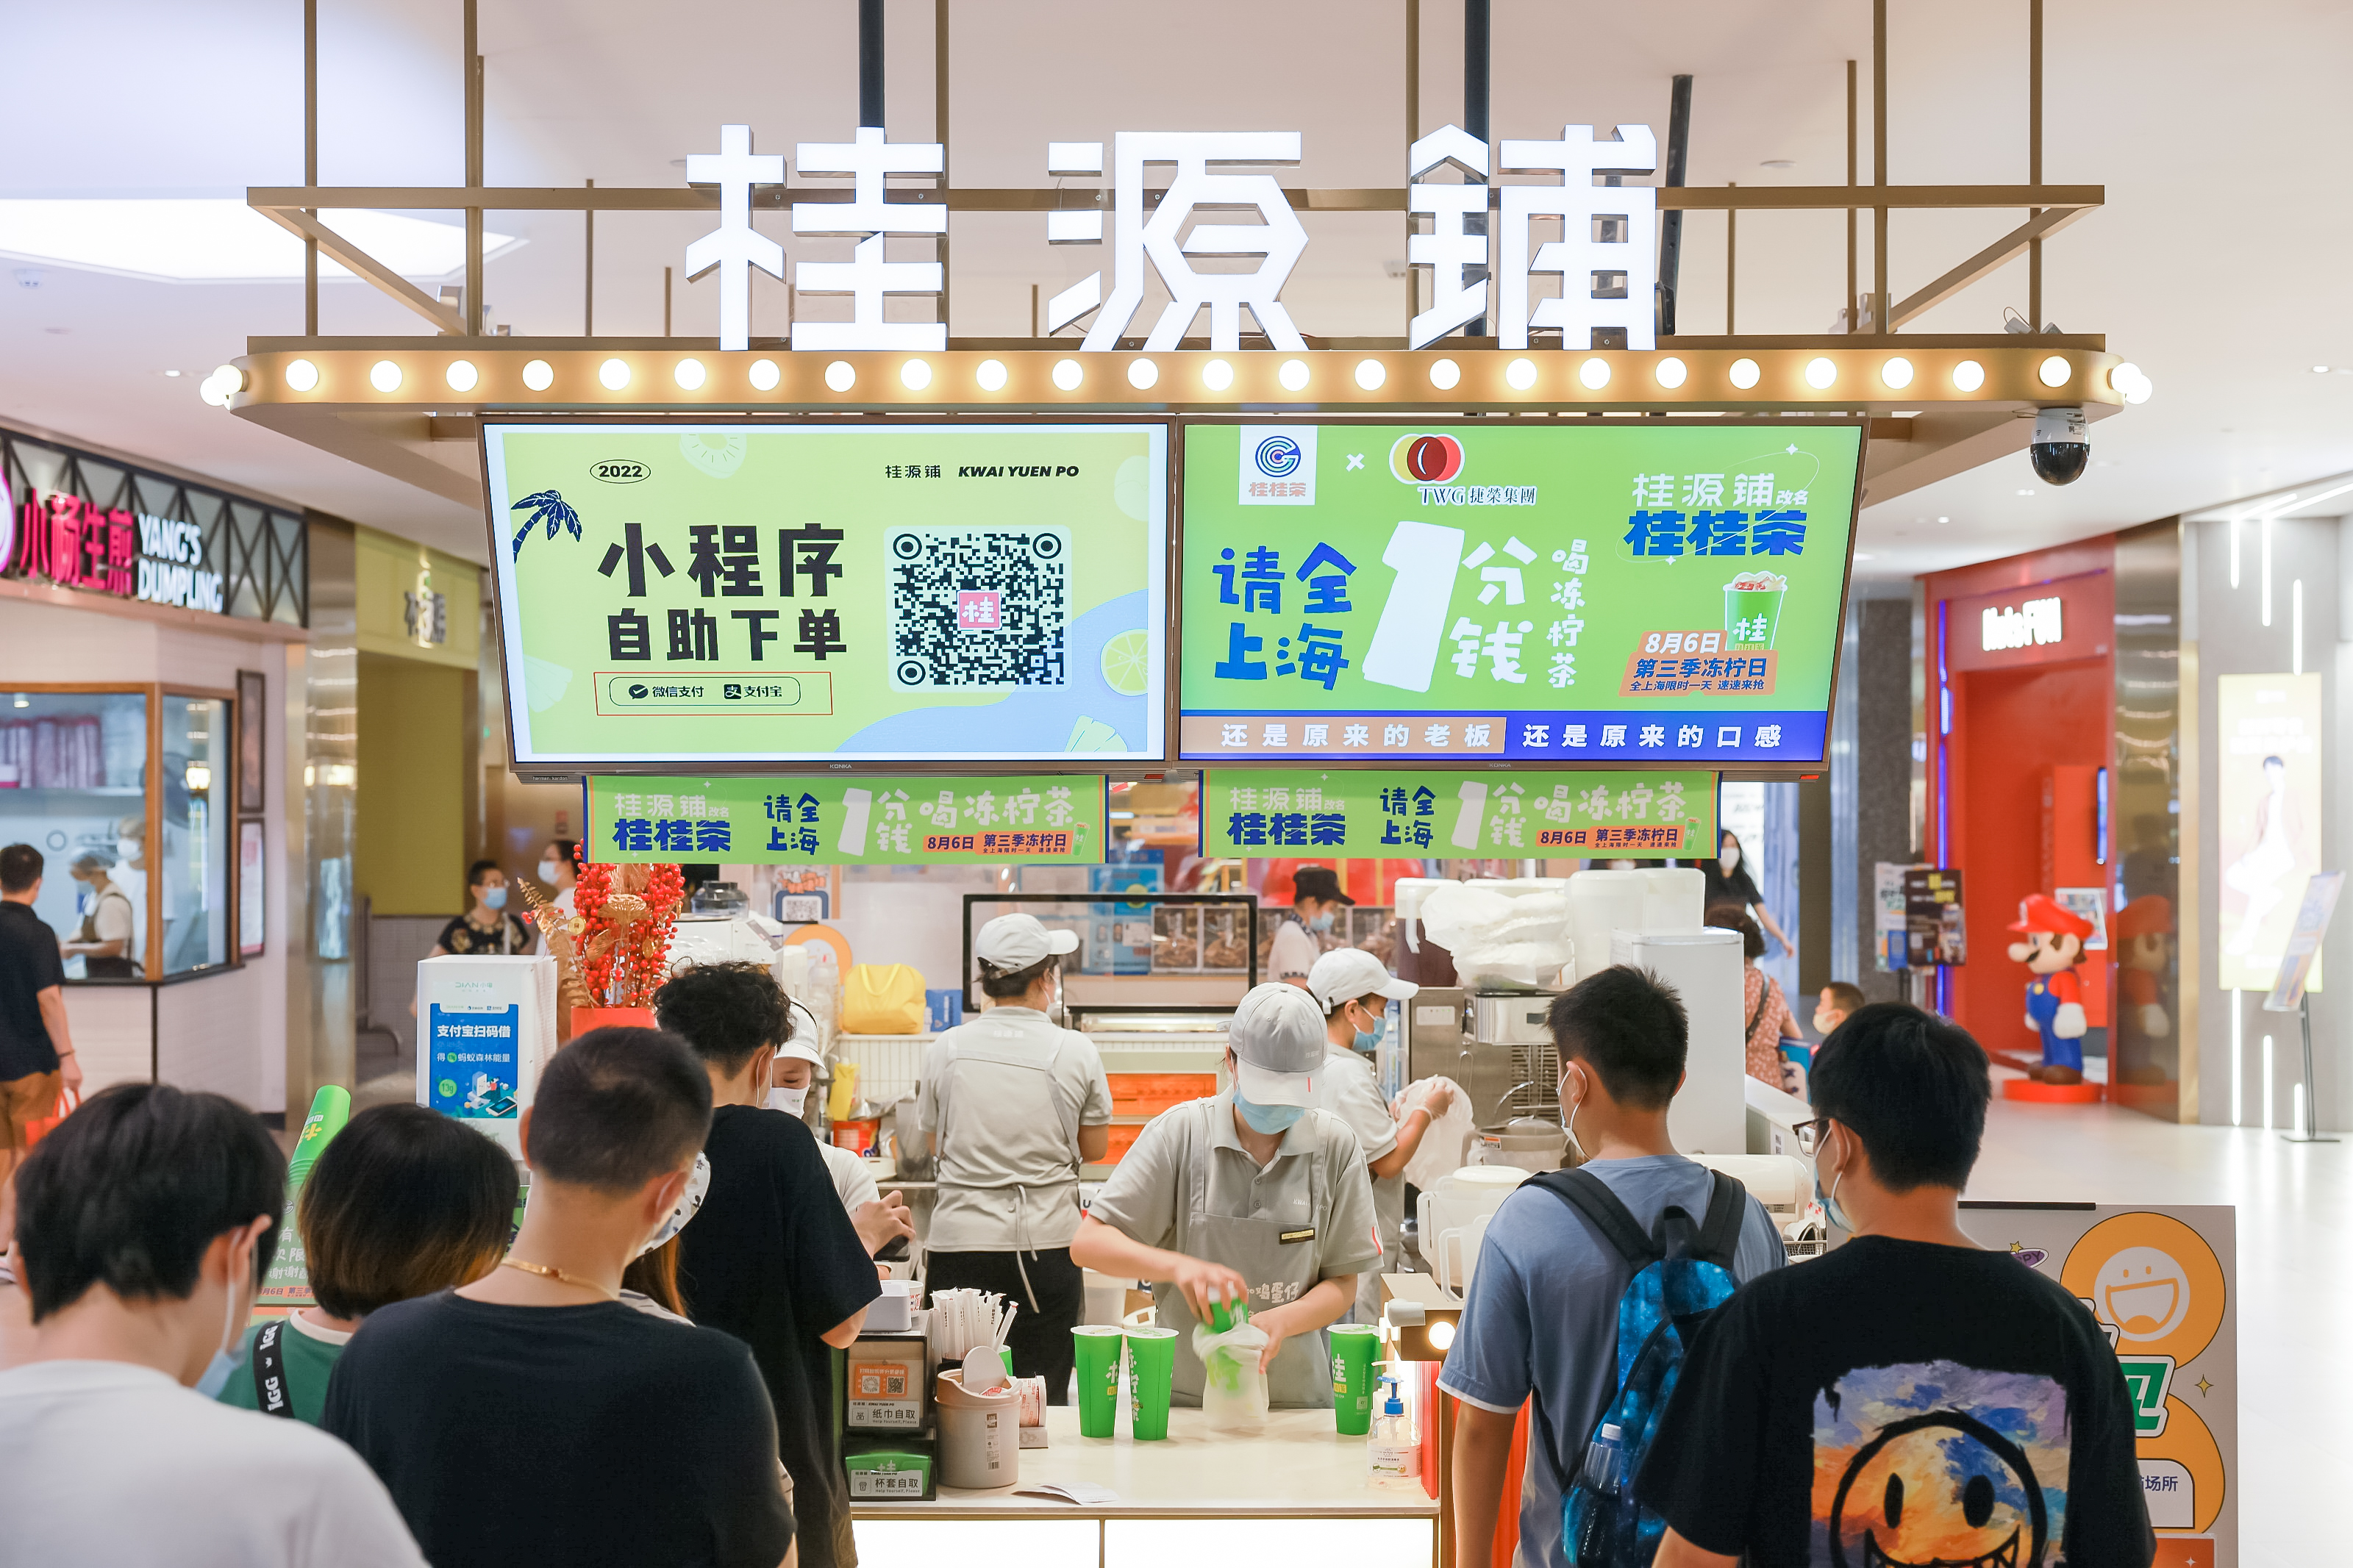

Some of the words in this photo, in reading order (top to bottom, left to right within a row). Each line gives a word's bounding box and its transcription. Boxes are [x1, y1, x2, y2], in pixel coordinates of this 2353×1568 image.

[599, 465, 643, 478] 2022
[958, 466, 1004, 477] KWAI
[1008, 466, 1051, 477] YUEN
[1055, 465, 1079, 477] PO
[1419, 487, 1464, 505] TWG
[1469, 487, 1537, 505] 捷榮集團
[138, 511, 203, 567] YANG'S
[597, 523, 845, 598] 小程序
[137, 556, 224, 615] DUMPLING
[962, 598, 996, 625] 桂
[1546, 539, 1589, 690] 喝冻柠茶
[607, 609, 847, 662] 自助下单
[1732, 613, 1768, 642] 桂
[1644, 632, 1721, 654] 8月6日
[1633, 658, 1767, 679] 第三季冻柠日
[652, 685, 704, 698] 微信支付
[744, 685, 783, 698] 支付宝
[1629, 680, 1713, 691] 全上海限时一天
[1718, 679, 1765, 690] 速速来抢
[1221, 724, 1491, 748] 还是原来的老板
[1523, 724, 1782, 748] 还是原来的口感
[919, 786, 1075, 828] 喝冻柠茶
[1534, 781, 1687, 823] 喝冻柠茶
[927, 836, 974, 850] 8月6日
[983, 833, 1067, 848] 第三季冻柠日
[1540, 831, 1587, 845] 8月6日
[1596, 828, 1679, 842] 第三季冻柠日
[437, 1024, 511, 1039] 支付宝扫码借
[437, 1053, 446, 1062] 得
[457, 1053, 510, 1063] 蚂蚁森林能量
[441, 1083, 454, 1095] 13g
[872, 1408, 915, 1419] 纸巾自取
[875, 1478, 918, 1489] 杯套自取
